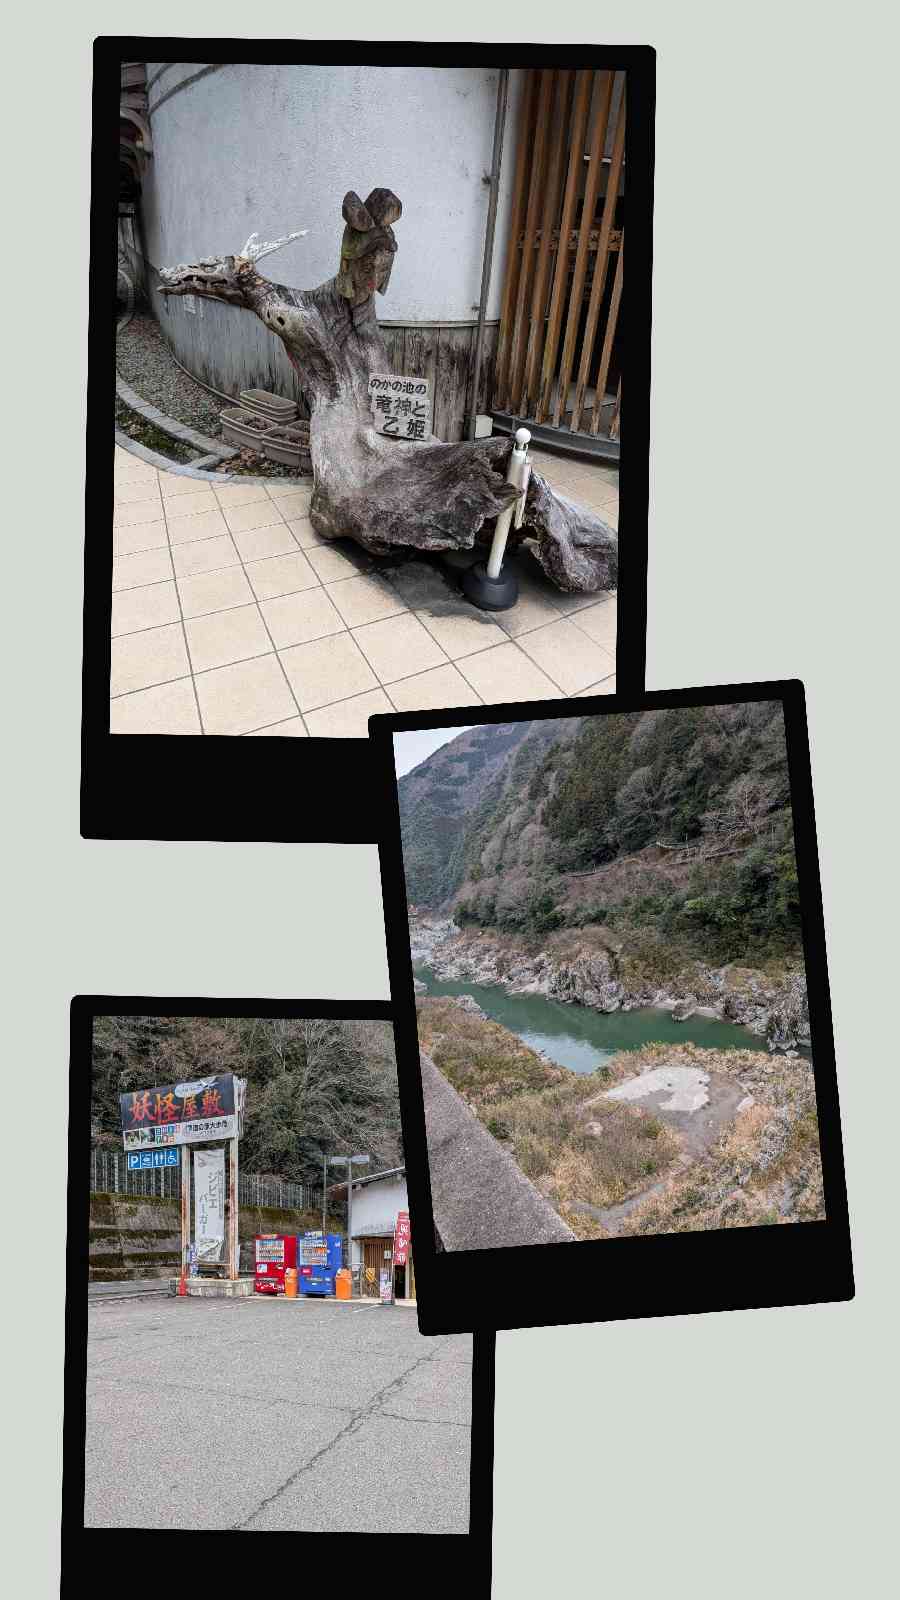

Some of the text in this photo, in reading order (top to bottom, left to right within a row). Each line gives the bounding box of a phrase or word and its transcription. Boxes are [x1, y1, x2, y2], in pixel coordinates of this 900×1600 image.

[375, 394, 426, 417] 竜神と
[128, 1088, 225, 1125] 妖怪屋敷
